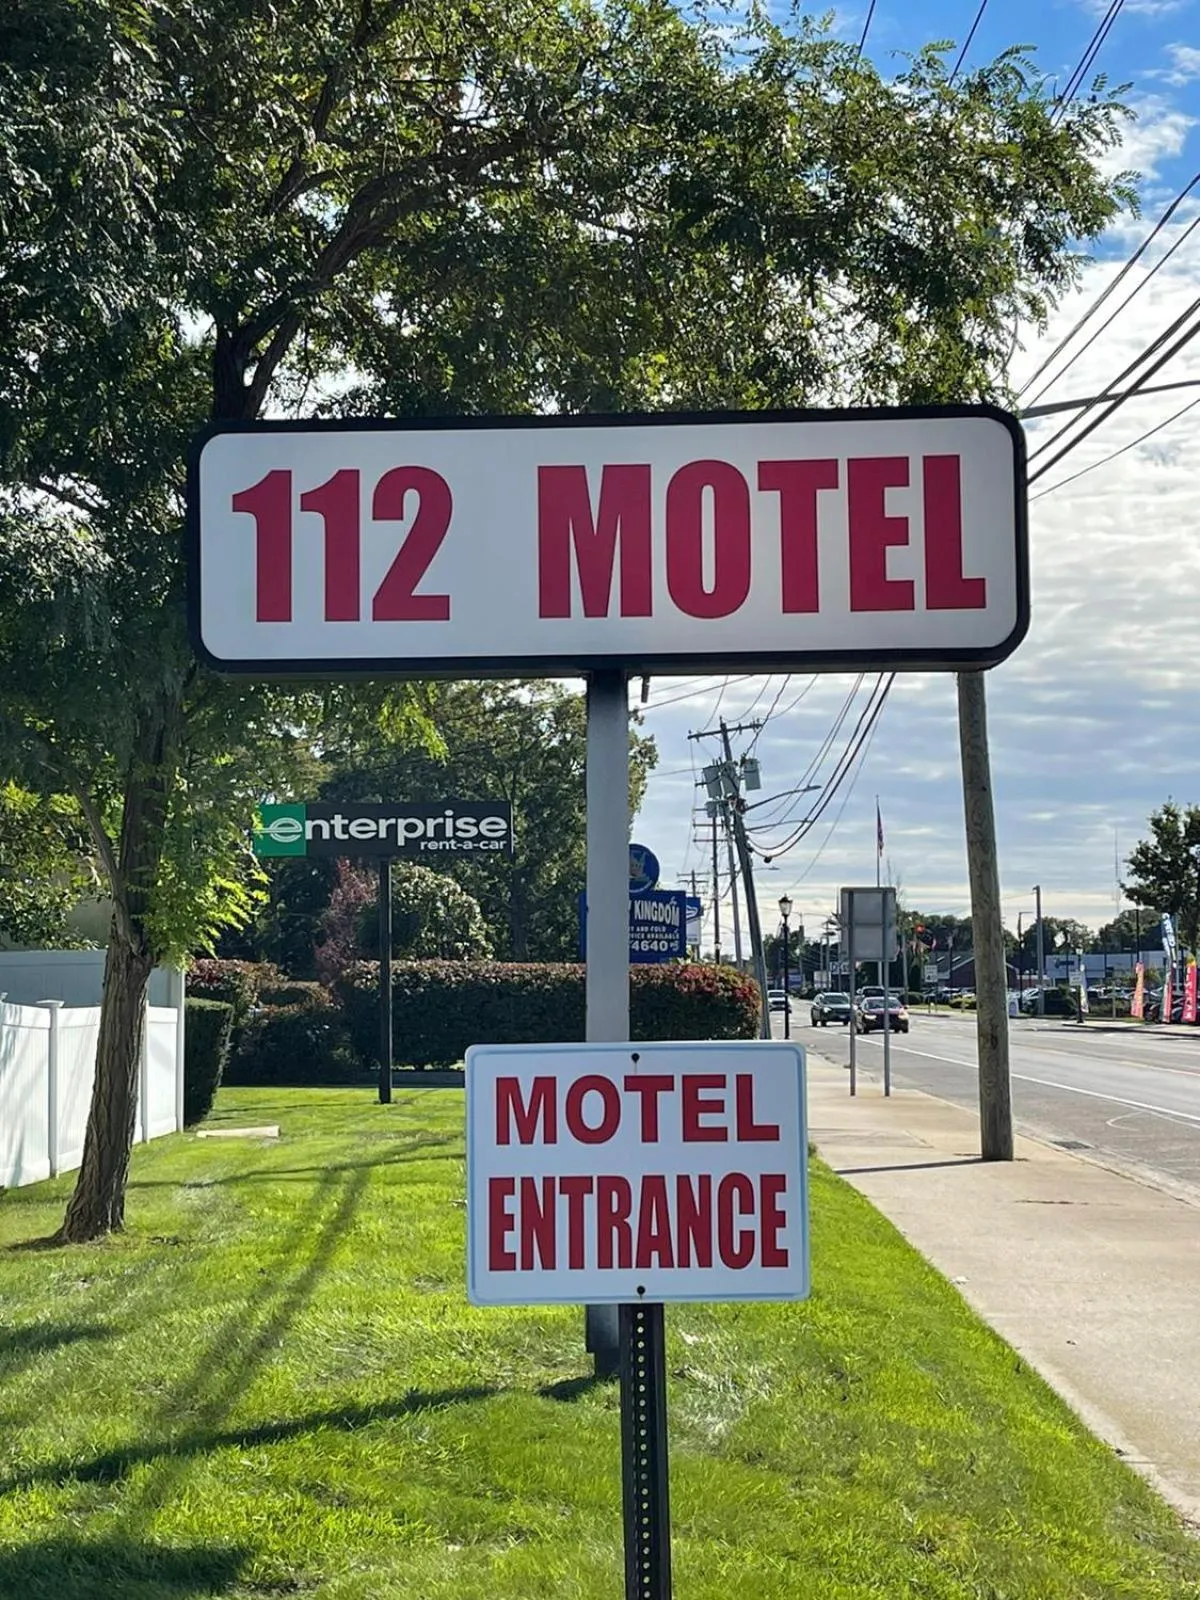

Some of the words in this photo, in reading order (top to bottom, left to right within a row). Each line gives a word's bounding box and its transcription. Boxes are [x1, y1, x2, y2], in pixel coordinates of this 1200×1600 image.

[231, 465, 454, 623] 112
[537, 454, 987, 620] MOTEL
[253, 809, 508, 847] enterprise
[419, 838, 508, 851] rent-a-car
[634, 900, 680, 928] KINGDOM
[495, 1074, 781, 1146] MOTEL
[488, 1172, 789, 1272] ENTRANCE
